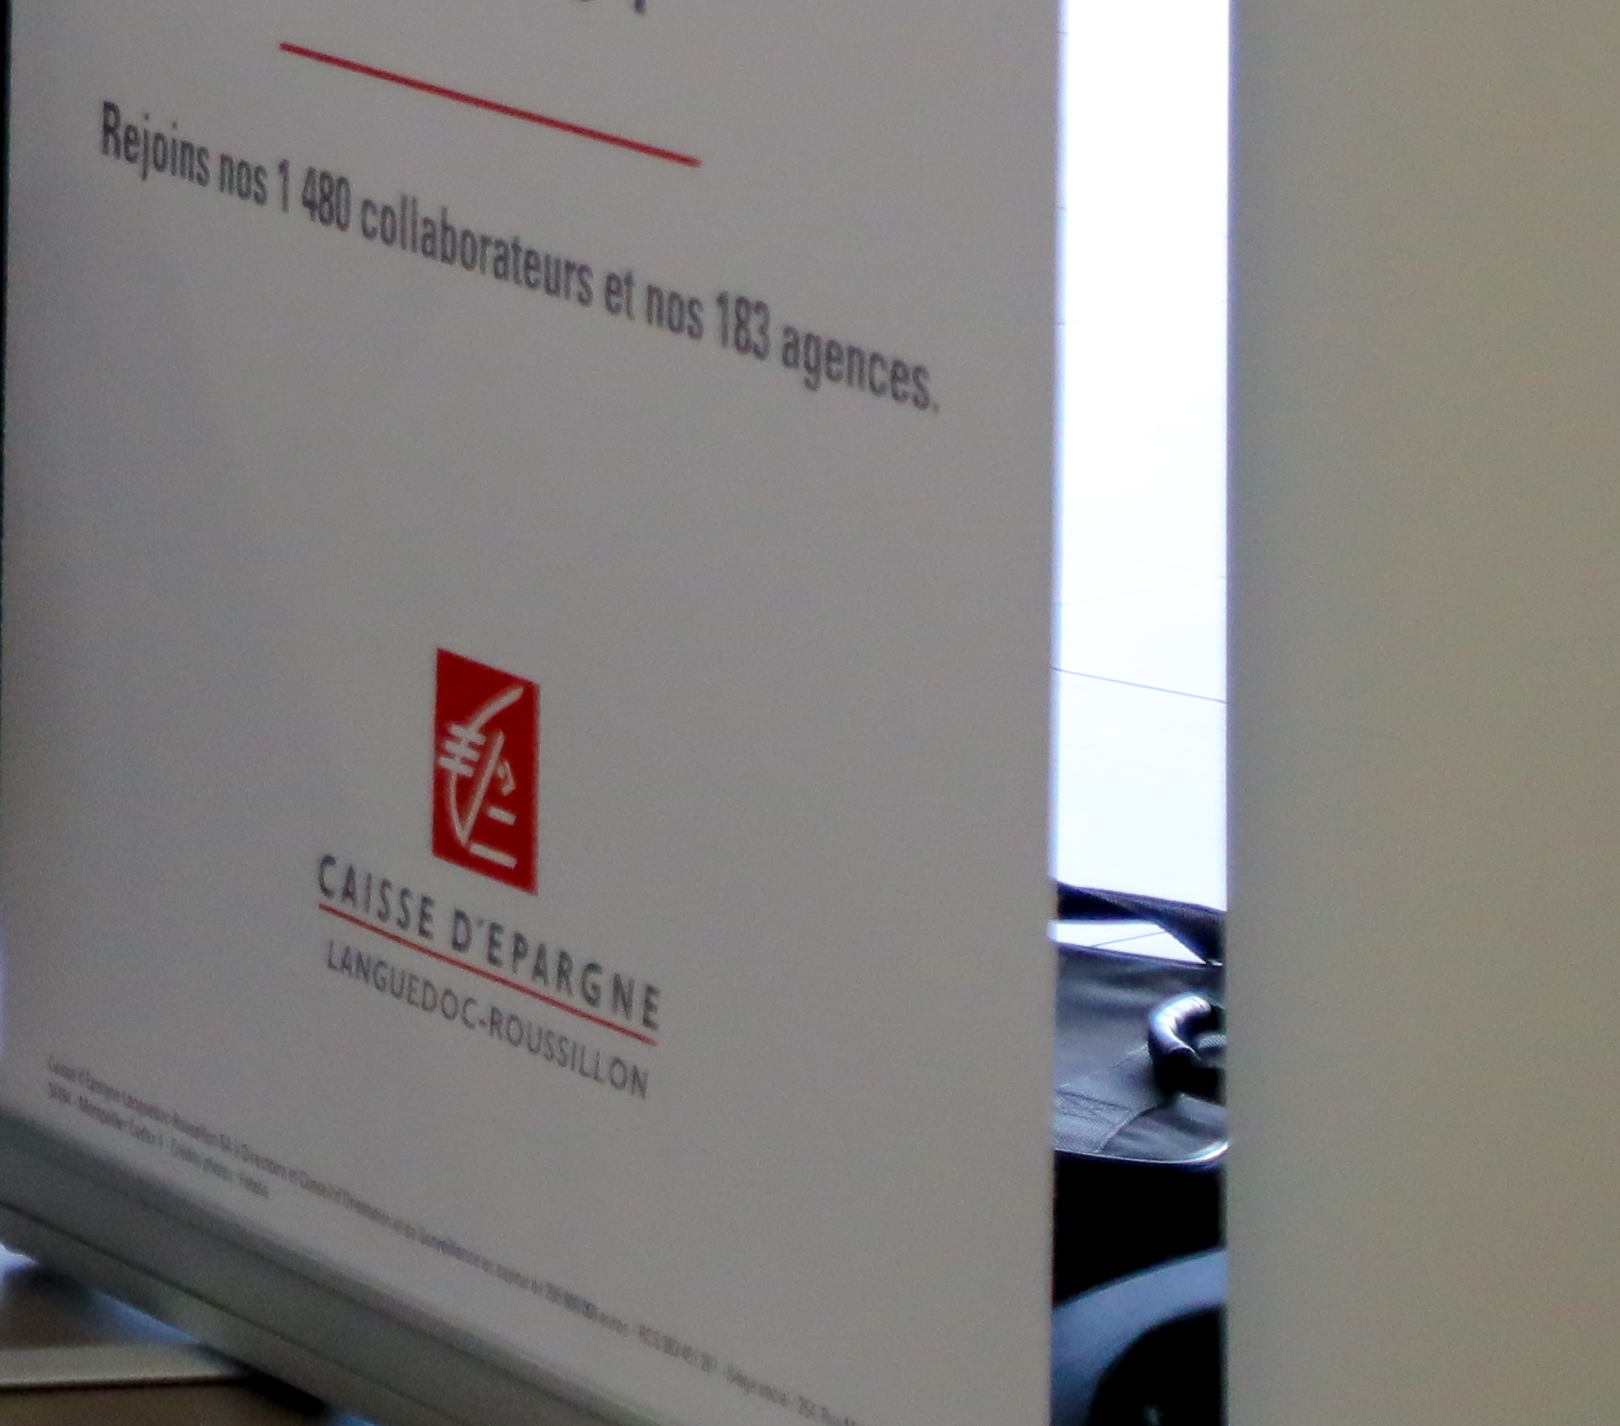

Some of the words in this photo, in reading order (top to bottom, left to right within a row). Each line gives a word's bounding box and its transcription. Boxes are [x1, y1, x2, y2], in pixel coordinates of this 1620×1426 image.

[100, 99, 212, 188] Rejoins
[217, 151, 269, 208] nos
[277, 158, 291, 214] 1
[300, 165, 353, 233] 480
[359, 192, 595, 308] collaborateurs
[603, 268, 637, 322] et
[644, 282, 705, 342] nos
[716, 290, 772, 362] 183
[780, 324, 940, 414] agences.
[317, 854, 436, 941] CAISSE
[450, 906, 661, 1032] D'EPARGNE
[326, 939, 650, 1101] LANGUEDOC-ROUSSILLON
